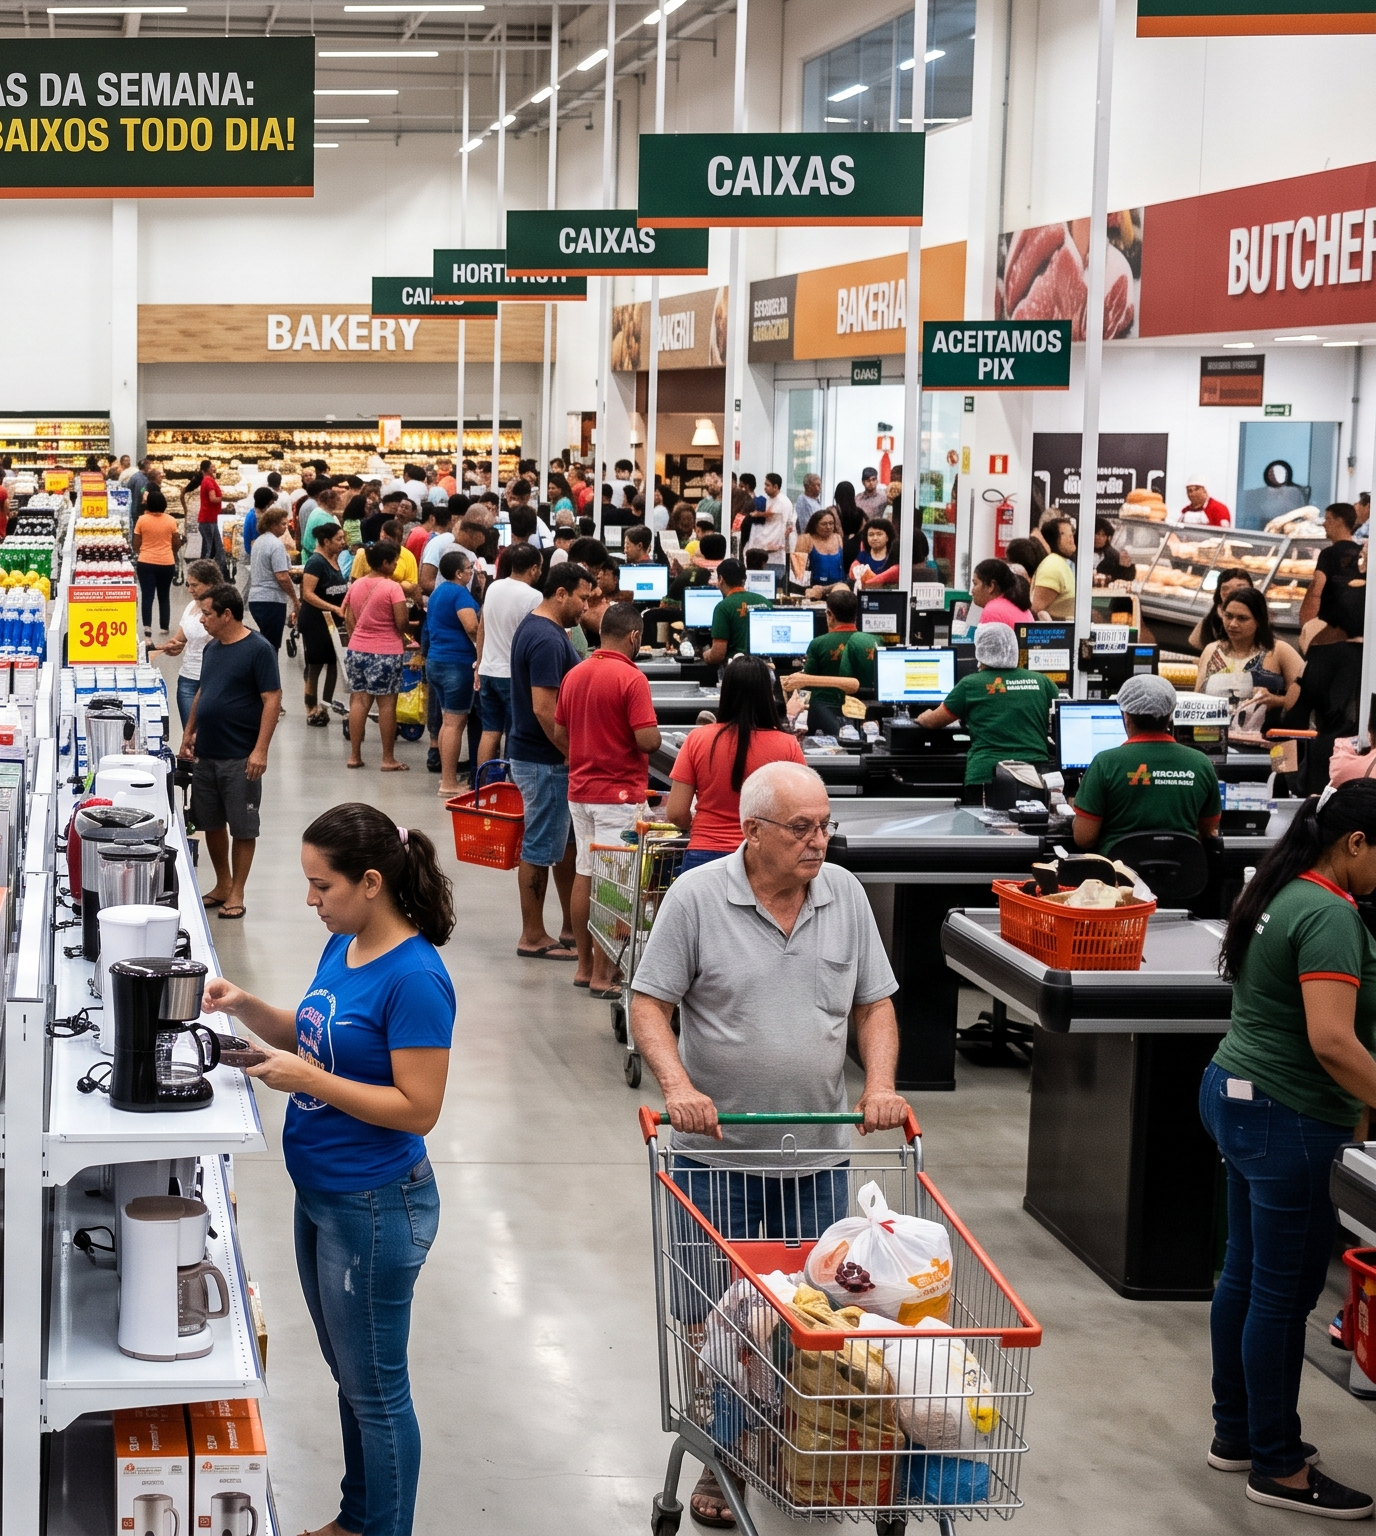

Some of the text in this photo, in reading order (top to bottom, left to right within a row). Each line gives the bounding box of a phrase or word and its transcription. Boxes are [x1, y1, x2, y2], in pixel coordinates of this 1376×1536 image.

[39, 72, 87, 106] DA
[97, 72, 254, 107] SEMANA:
[120, 117, 213, 151] TODO
[225, 117, 295, 151] DIA!
[707, 155, 855, 197] CAIXAS
[559, 228, 655, 254] CAIXAS
[837, 278, 906, 335] BAKERIA
[267, 314, 421, 351] BAKERY
[931, 330, 1062, 353] ACEITAMOS
[978, 358, 1015, 380] PIX
